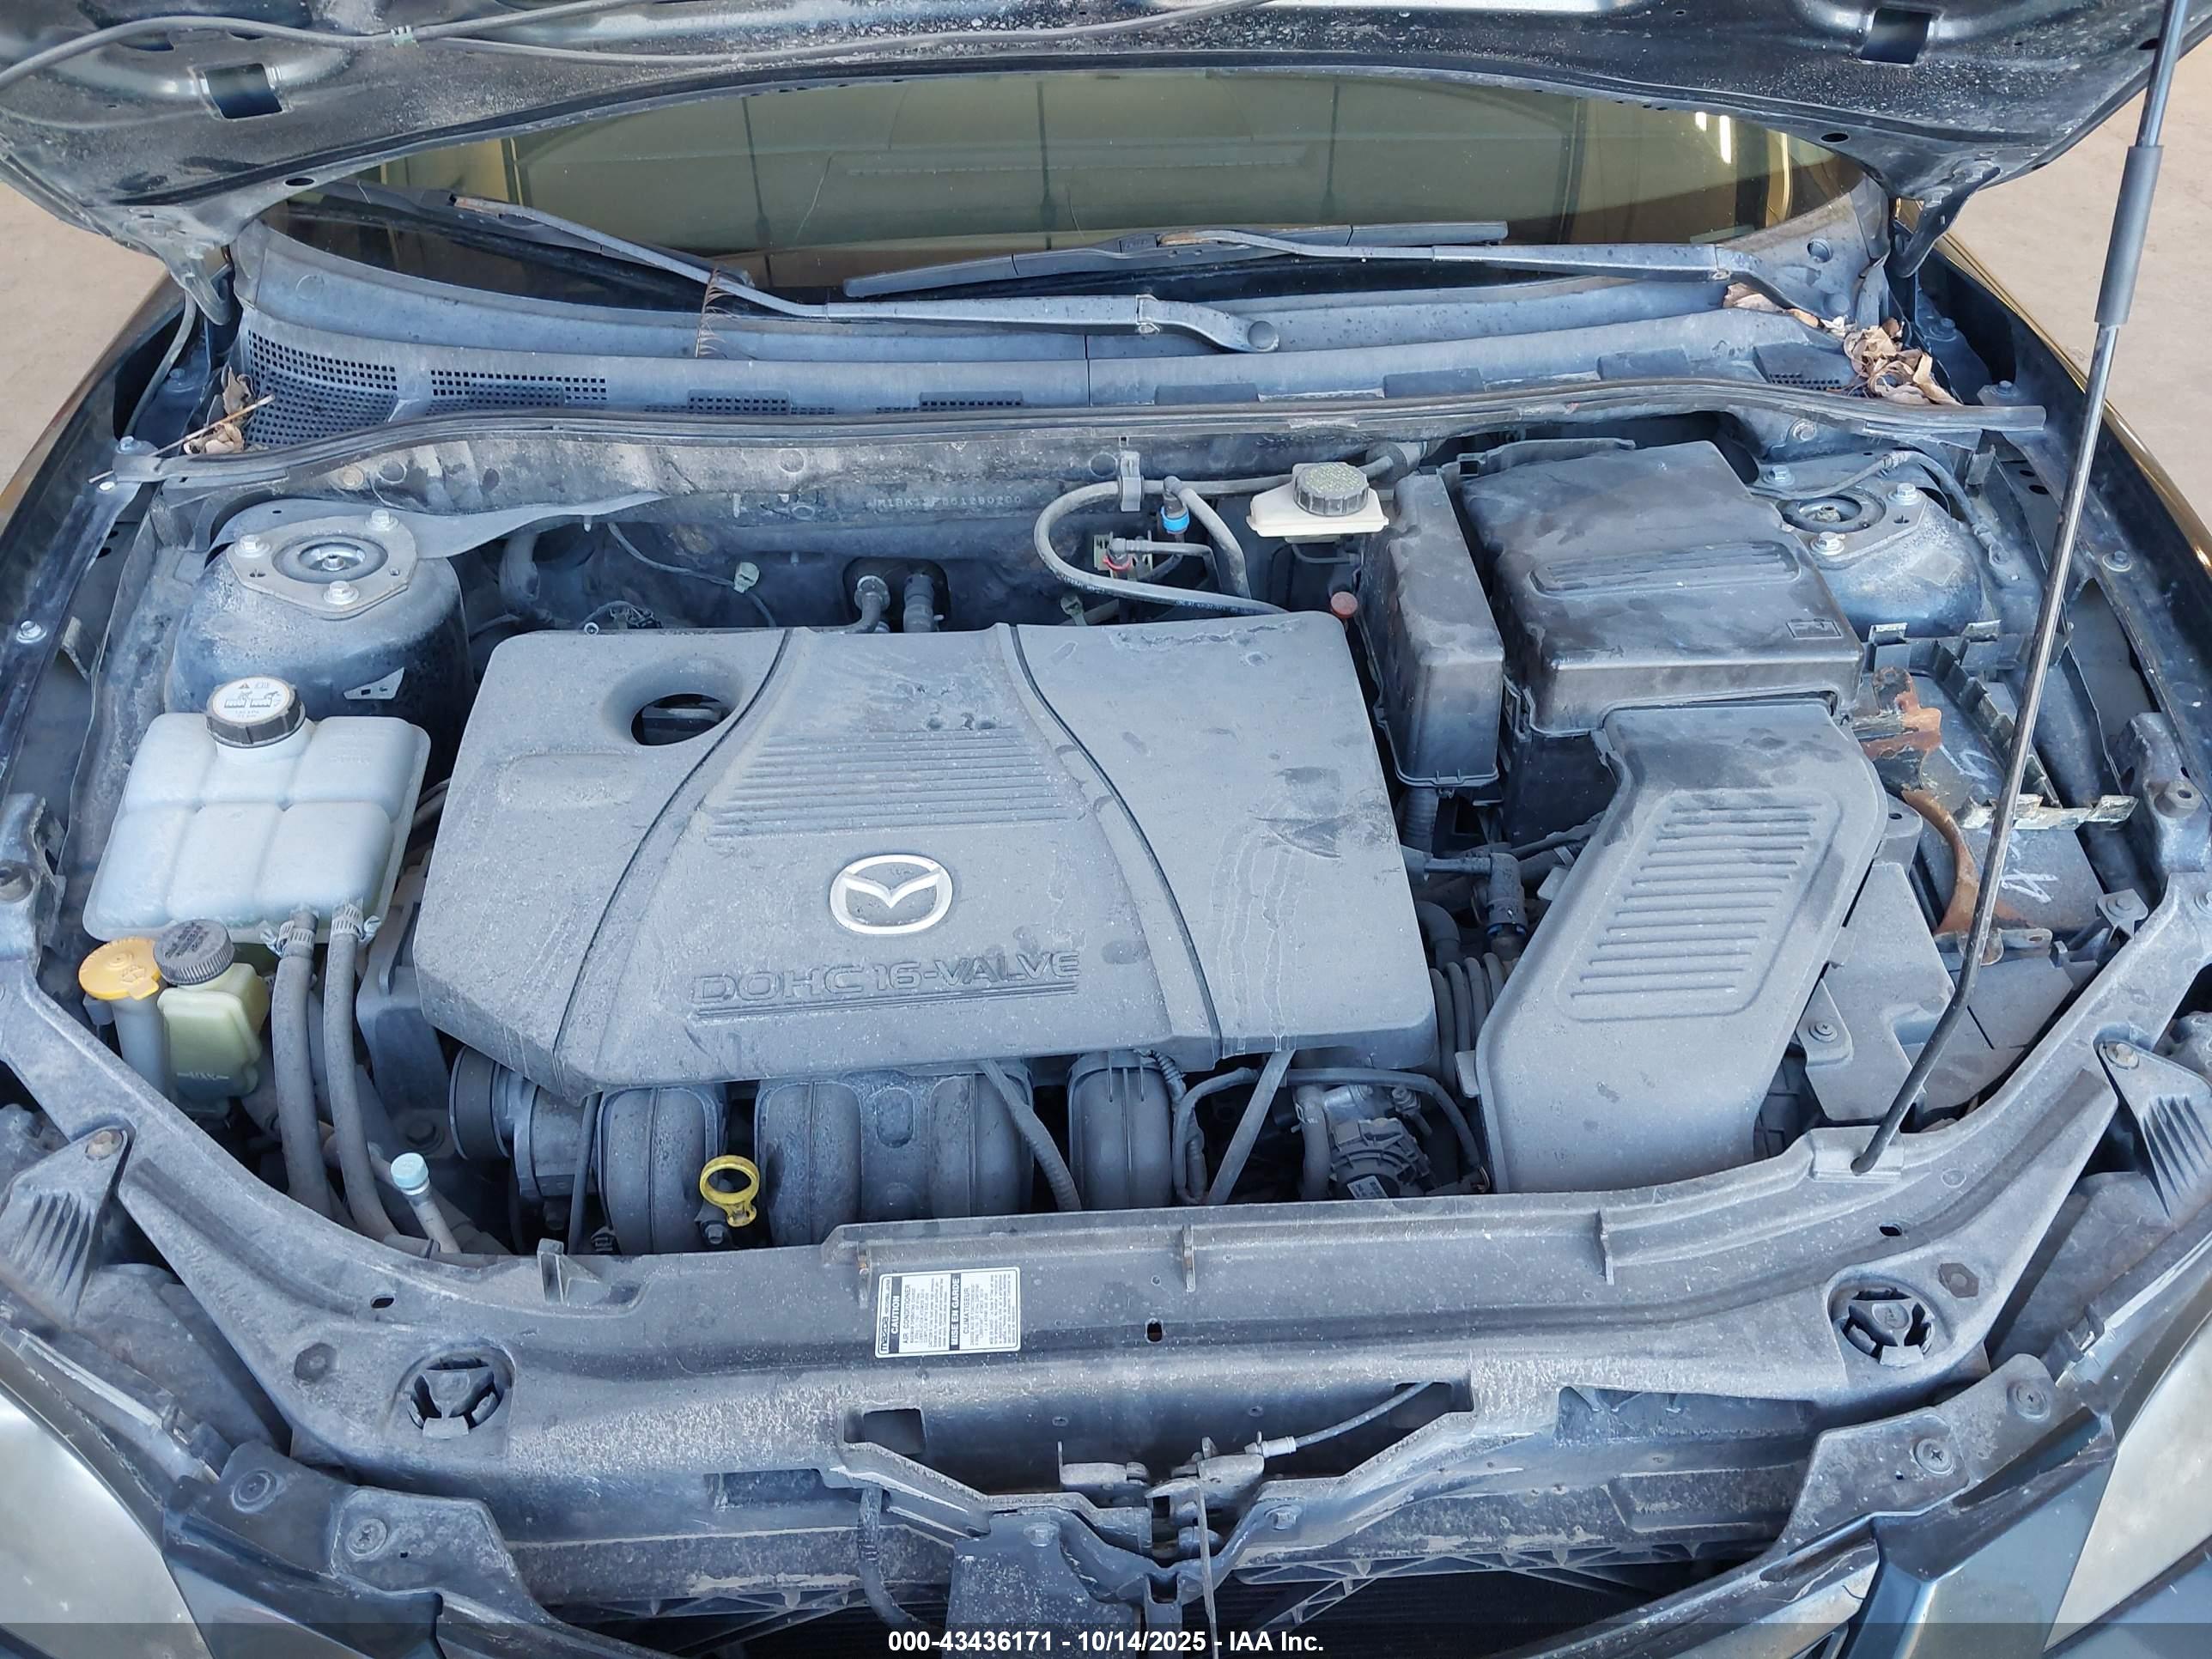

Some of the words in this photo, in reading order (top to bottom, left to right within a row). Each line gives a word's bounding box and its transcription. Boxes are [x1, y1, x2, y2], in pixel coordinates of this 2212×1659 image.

[692, 963, 866, 1003] DOHC
[874, 951, 1081, 990] 16-VALVE
[891, 1296, 900, 1334] CAUTION
[951, 1310, 959, 1322] EN
